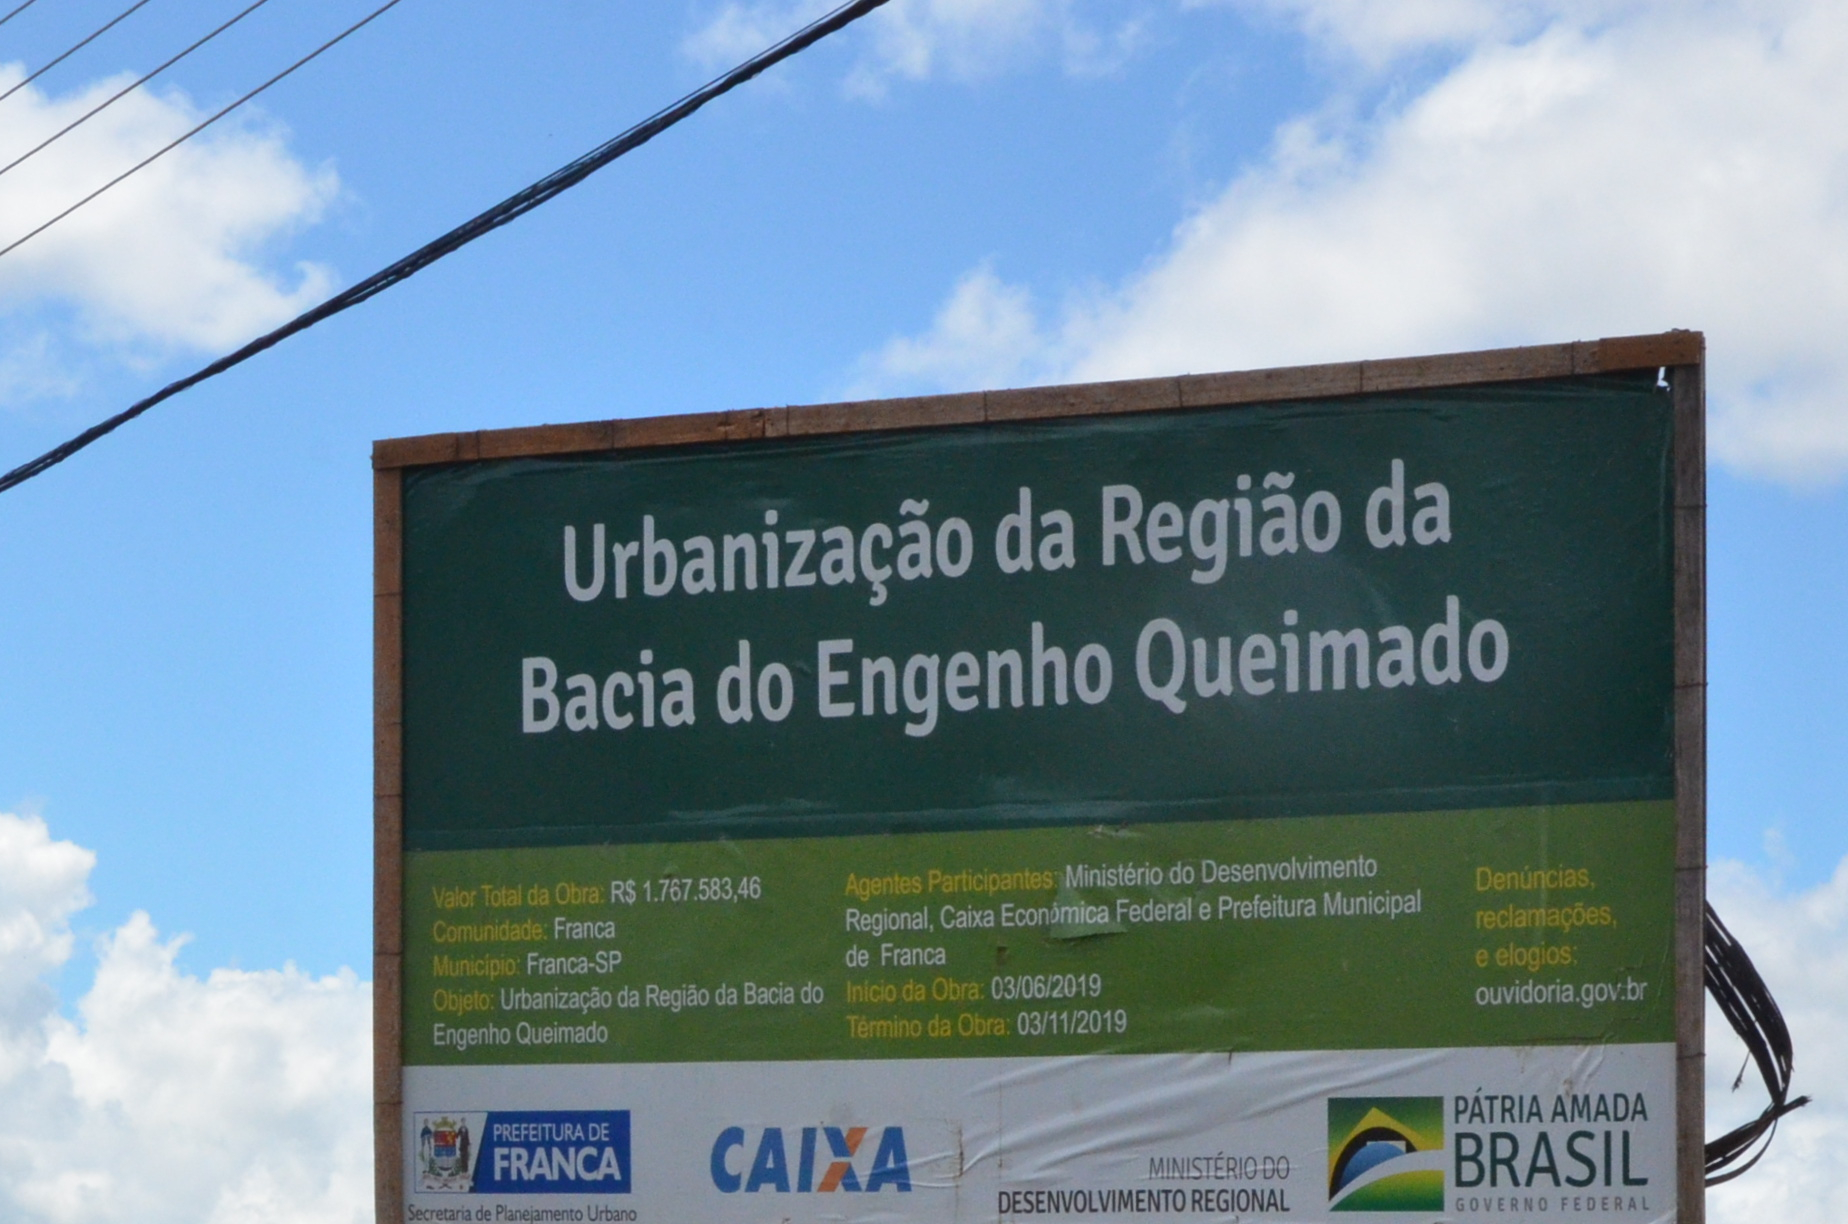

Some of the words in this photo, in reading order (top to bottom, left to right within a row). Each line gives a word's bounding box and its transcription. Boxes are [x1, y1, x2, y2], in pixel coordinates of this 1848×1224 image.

[564, 498, 973, 606] Urbanização
[995, 486, 1075, 574] da
[1102, 472, 1341, 584] Região
[1366, 458, 1451, 548] da
[522, 649, 695, 733] Bacia
[717, 639, 793, 724] do
[818, 621, 1113, 737] Engenho
[1136, 595, 1509, 714] Queimado
[433, 885, 476, 908] Valor
[481, 884, 522, 907] Total
[527, 883, 549, 906] da
[556, 882, 605, 905] Obra:
[611, 879, 636, 905] R$
[643, 876, 762, 903] 1.767.583,46
[845, 873, 922, 901] Agentes
[928, 868, 1058, 895] Participantes:
[1065, 861, 1163, 888] Ministério
[1169, 861, 1195, 885] do
[1201, 855, 1378, 884] Desenvolvimento
[1476, 864, 1595, 892] Denúncias,
[846, 906, 934, 937] Regional,
[940, 904, 994, 929] Caixa
[1001, 901, 1109, 927] Econômica
[1116, 897, 1192, 923] Federal
[1198, 901, 1212, 921] e
[1218, 893, 1316, 920] Prefeitura
[1323, 888, 1422, 920] Municipal
[1475, 902, 1617, 933] reclamações,
[433, 919, 548, 942] Comunidade:
[554, 917, 615, 939] Franca
[433, 954, 521, 981] Município:
[527, 950, 622, 975] Franca-SP
[846, 945, 869, 968] de
[881, 943, 946, 966] Franca
[1475, 948, 1489, 968] e
[433, 988, 494, 1016] Objeto:
[501, 986, 612, 1014] Urbanização
[618, 985, 639, 1008] da
[646, 984, 710, 1013] Região
[715, 983, 737, 1006] da
[744, 982, 794, 1005] Bacia
[801, 981, 824, 1004] do
[846, 978, 897, 1003] Início
[902, 978, 927, 1002] da
[932, 976, 985, 1001] Obra:
[991, 973, 1102, 1000] 03/06/2019
[1475, 976, 1648, 1009] ouvidoria.gov.br
[433, 1022, 511, 1051] Engenho
[516, 1021, 608, 1045] Queimado
[846, 1014, 922, 1039] Término
[927, 1014, 952, 1037] da
[957, 1012, 1011, 1037] Obra:
[1017, 1009, 1128, 1036] 03/11/2019
[1455, 1086, 1543, 1124] PÁTRIA
[1551, 1092, 1648, 1123] AMADA
[493, 1123, 584, 1142] PREFEITURA
[589, 1123, 610, 1141] DE
[494, 1146, 622, 1182] FRANCA
[710, 1126, 912, 1194] CAIXA
[1149, 1151, 1257, 1181] MINISTÉRIO
[1263, 1155, 1290, 1180] DO
[1455, 1130, 1649, 1188] BRASIL
[408, 1204, 472, 1222] Secretaria
[476, 1205, 492, 1222] de
[587, 1204, 637, 1222] Urbano
[998, 1188, 1187, 1214] DESENVOLVIMENTO
[1191, 1188, 1290, 1213] REGIONAL
[1456, 1197, 1548, 1212] GOVERNO
[1561, 1196, 1650, 1211] FEDERAL
